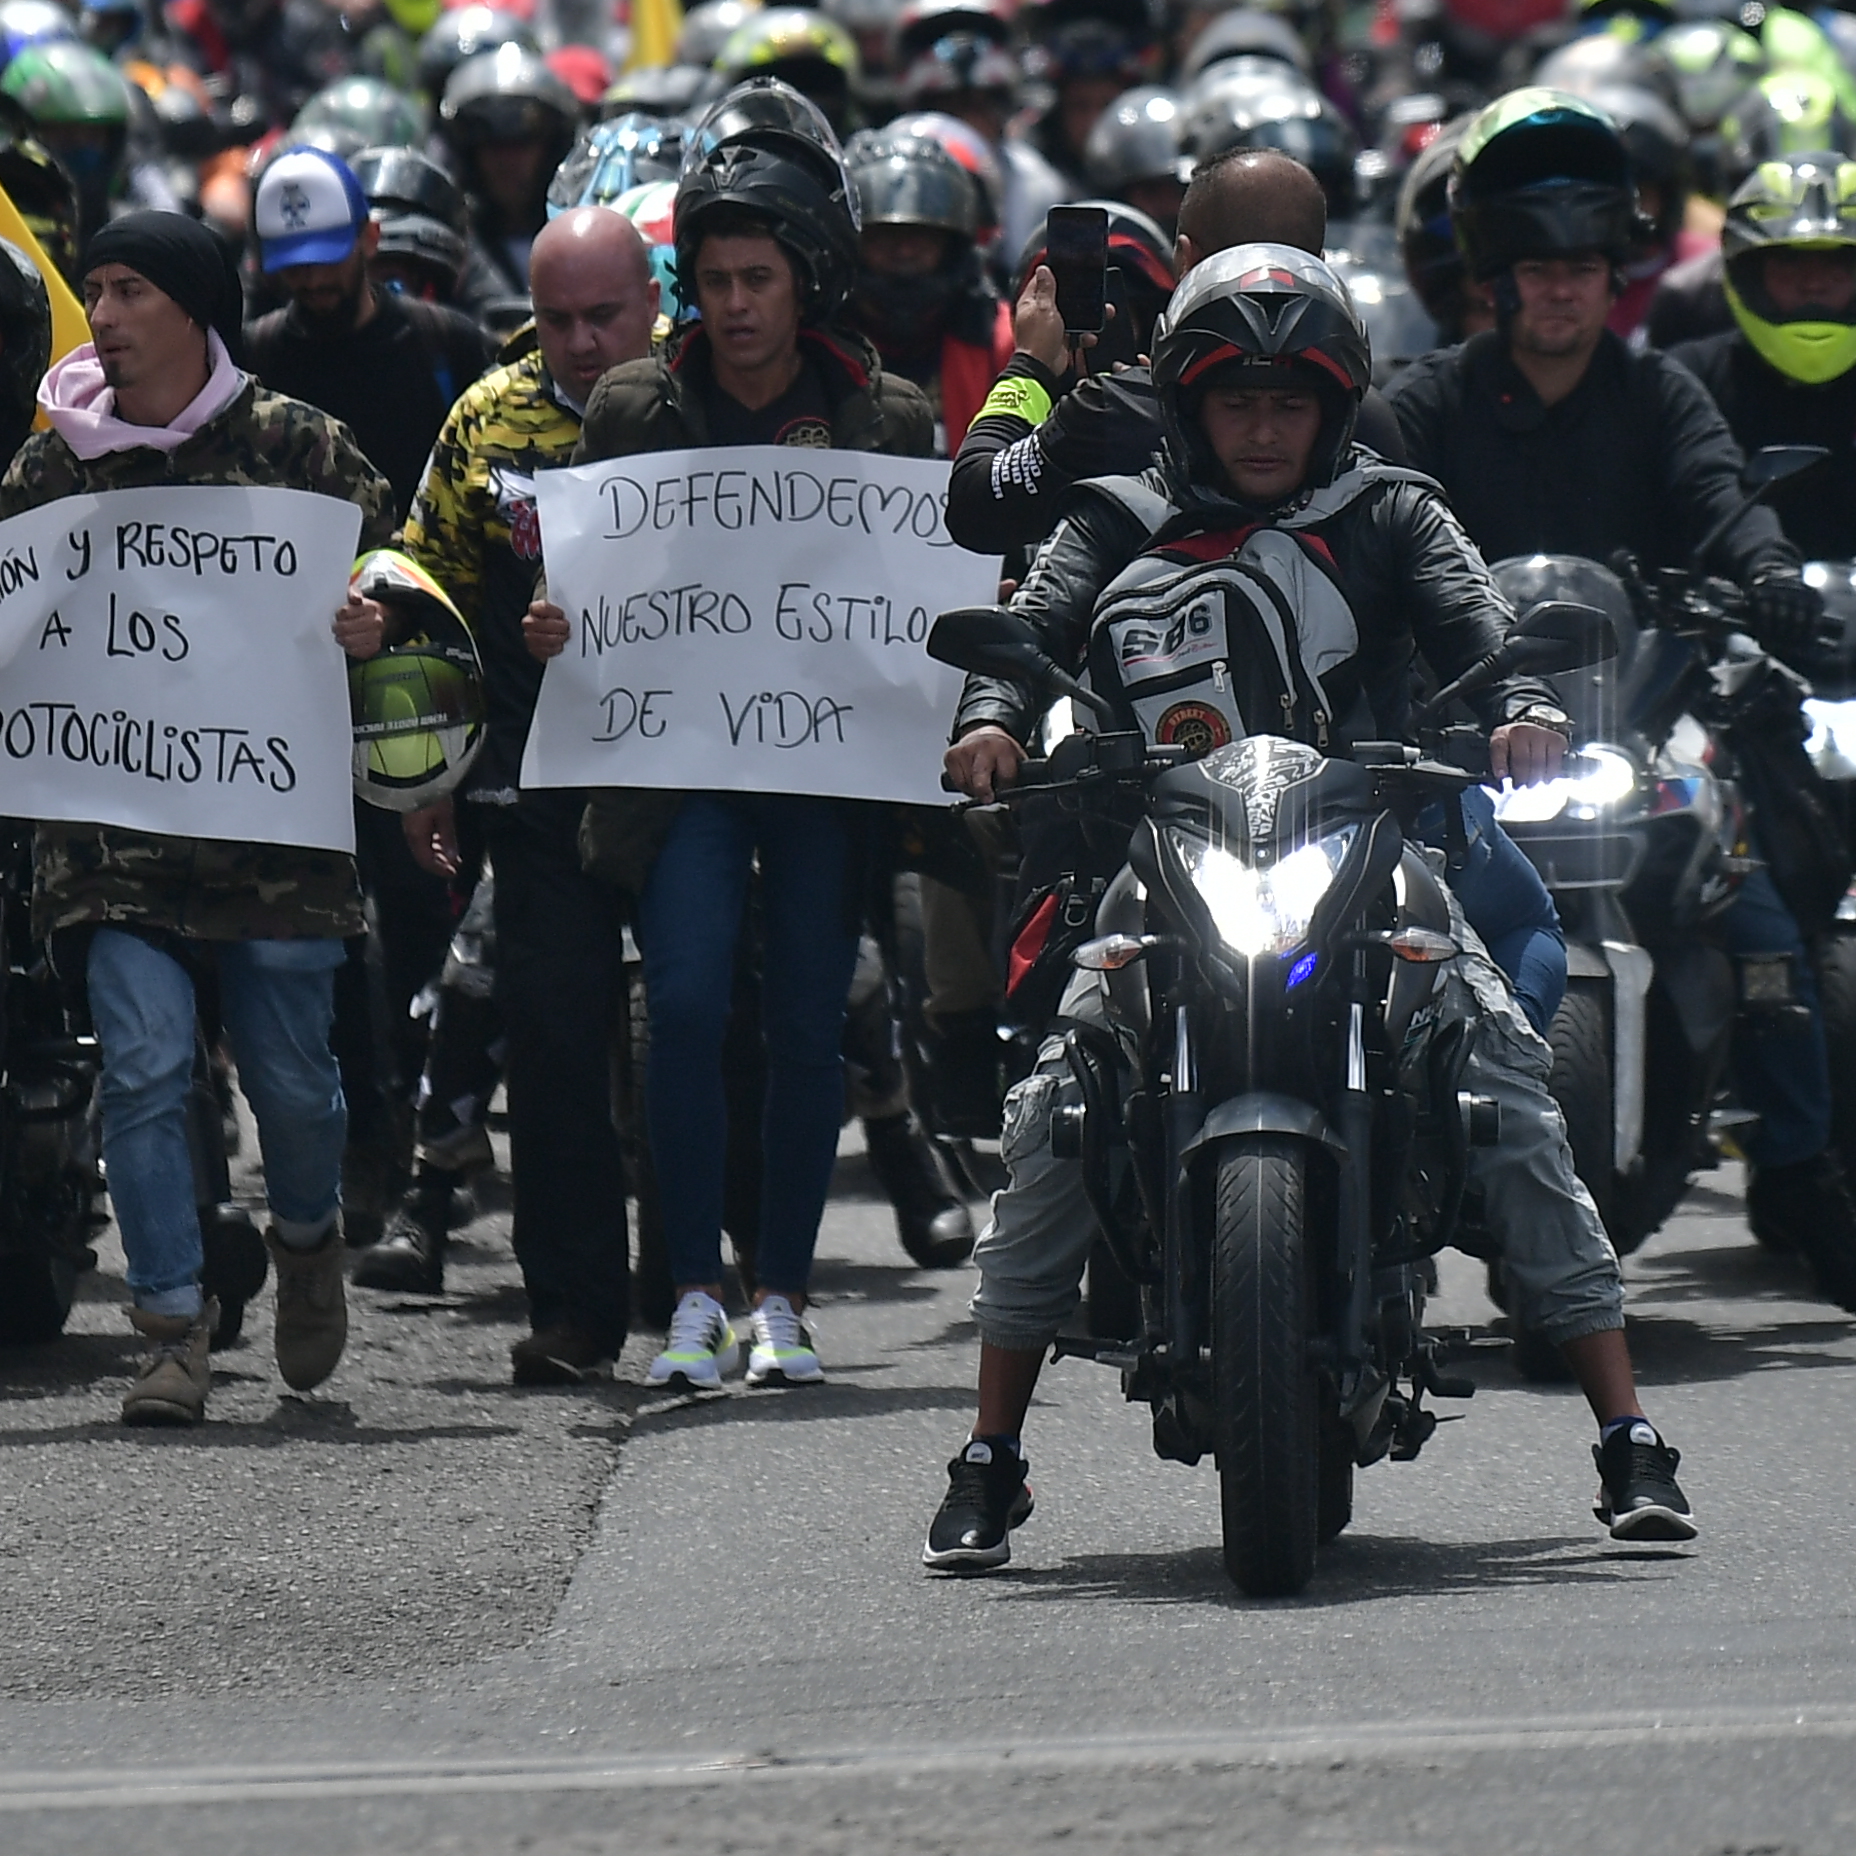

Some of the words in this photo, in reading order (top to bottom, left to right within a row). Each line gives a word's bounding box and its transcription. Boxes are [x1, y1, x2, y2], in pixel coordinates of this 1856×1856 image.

[65, 527, 92, 582] Y
[115, 520, 298, 578] RESPETO
[38, 608, 74, 652] A
[105, 591, 191, 663] LOS
[580, 582, 753, 660] NUESTRO
[590, 686, 675, 744] DE
